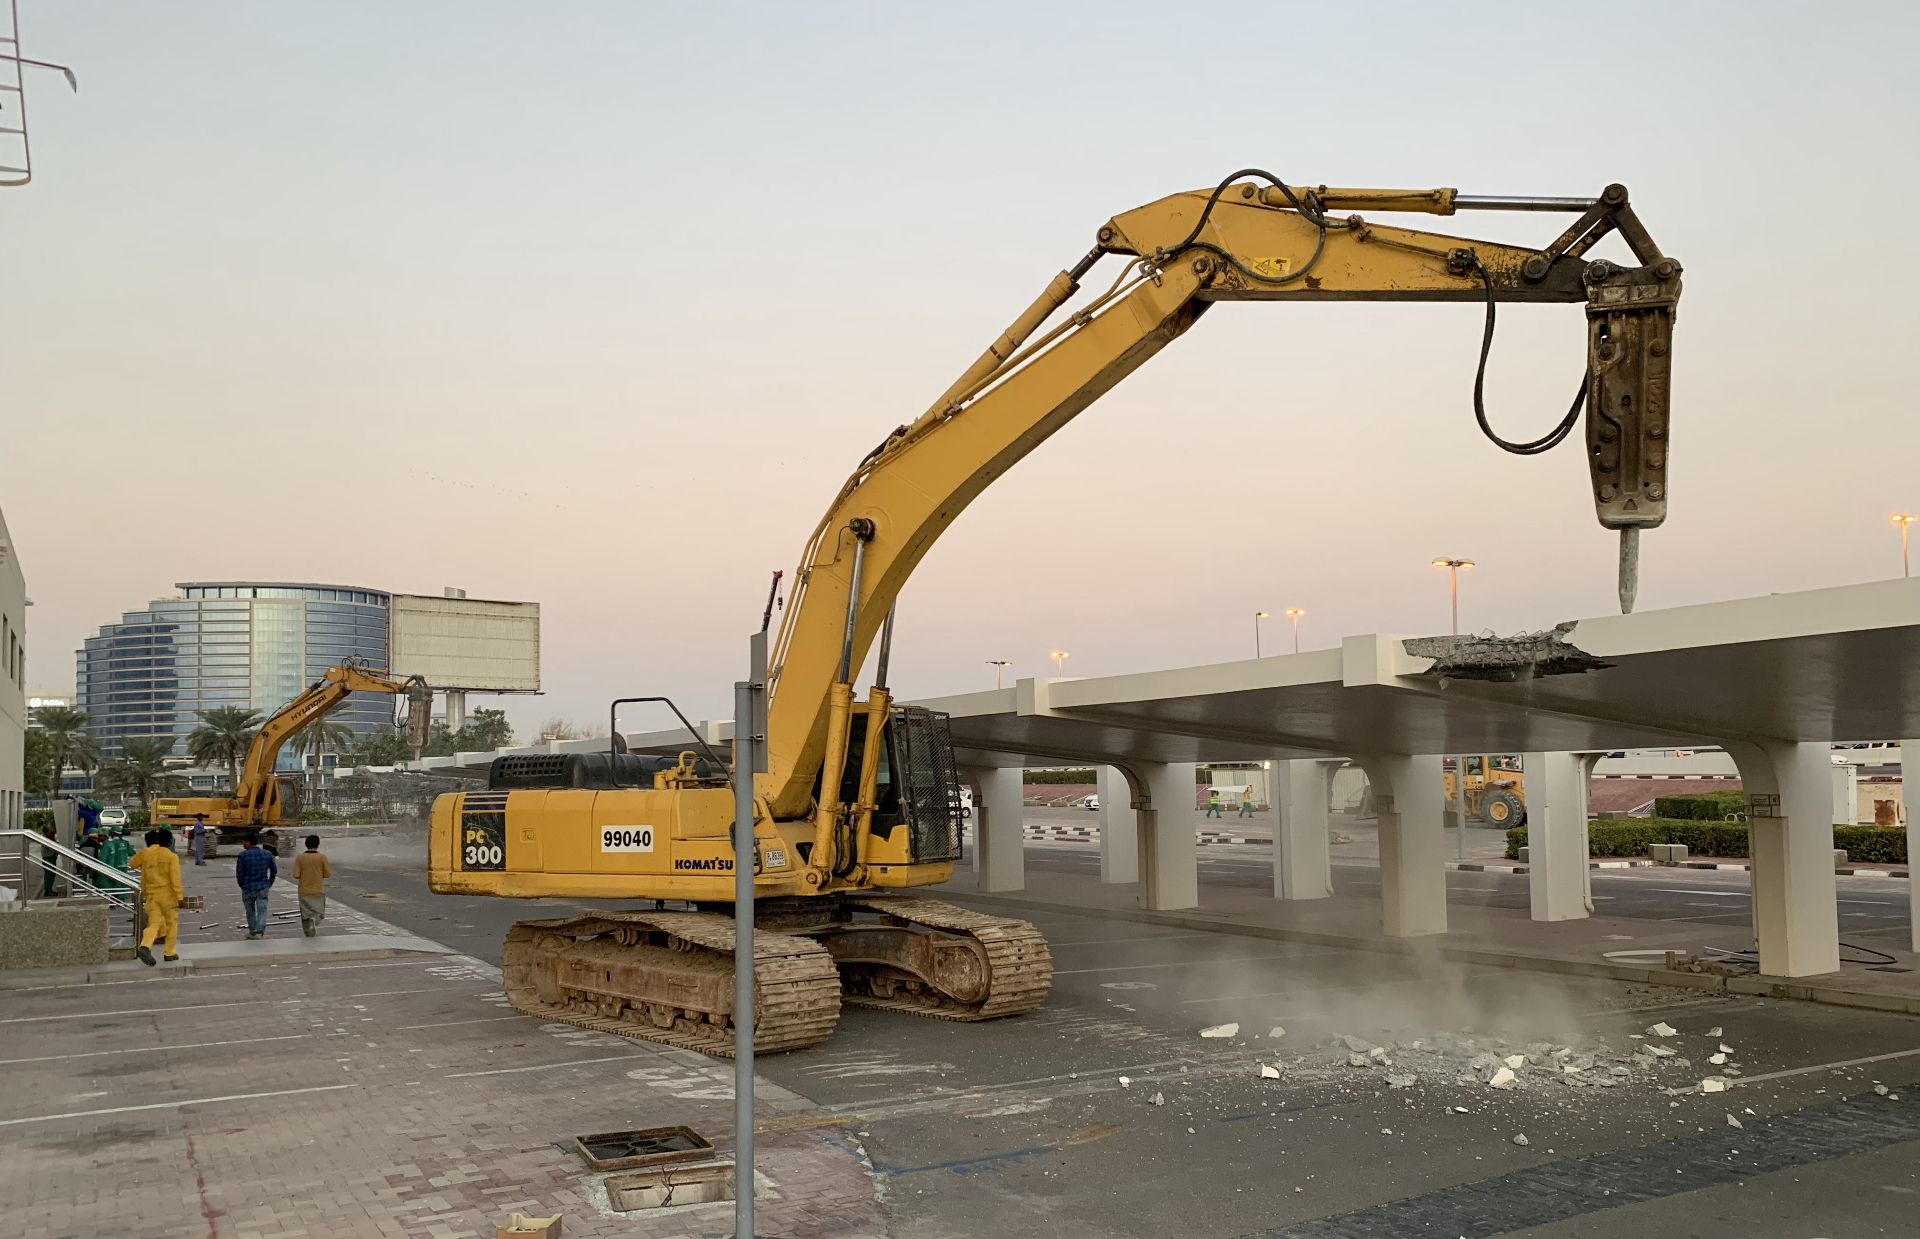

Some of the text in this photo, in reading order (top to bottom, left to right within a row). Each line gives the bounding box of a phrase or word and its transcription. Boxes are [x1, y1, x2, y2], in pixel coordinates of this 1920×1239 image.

[291, 695, 327, 721] HYUNDAI
[466, 830, 485, 844] PC
[603, 830, 651, 847] 99040
[465, 845, 502, 865] 300
[674, 856, 734, 870] KOMATSU
